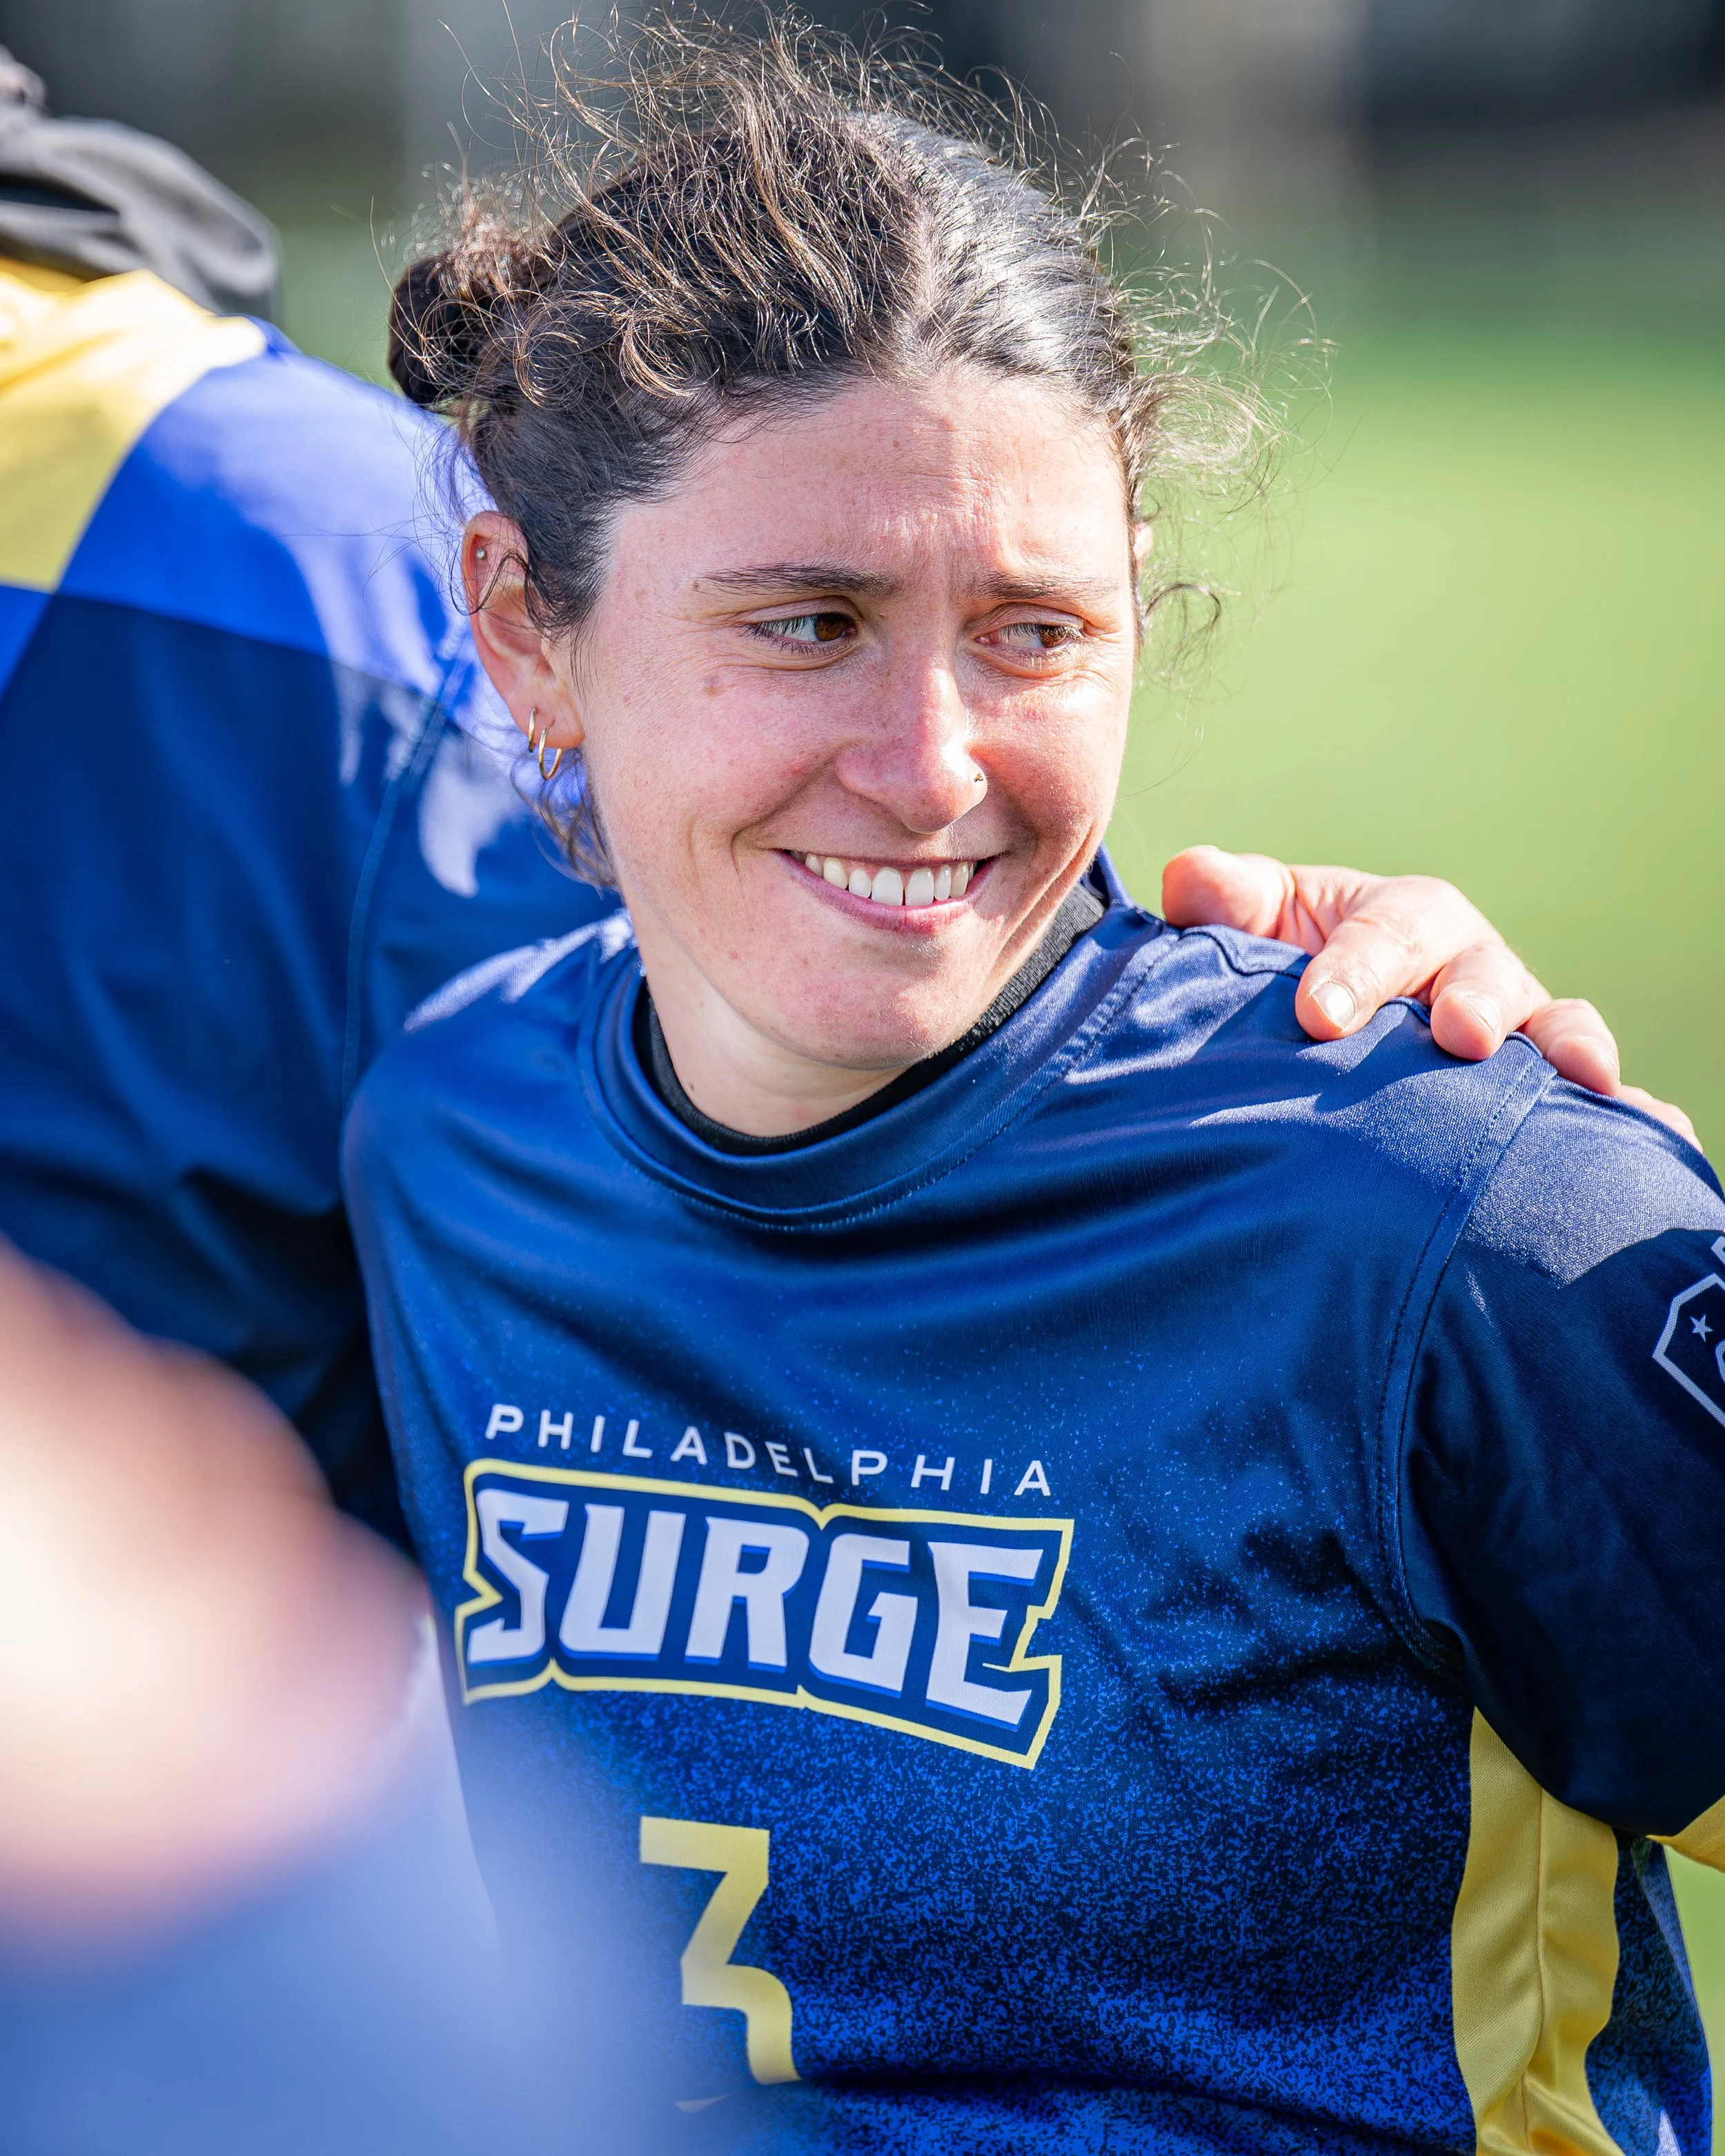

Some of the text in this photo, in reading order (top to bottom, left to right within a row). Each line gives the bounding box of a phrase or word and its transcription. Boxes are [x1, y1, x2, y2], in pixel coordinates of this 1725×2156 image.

[485, 1403, 1052, 1496] PHILADELPHIA
[466, 1487, 1044, 1729] SURGE
[640, 1815, 802, 2113] 3
